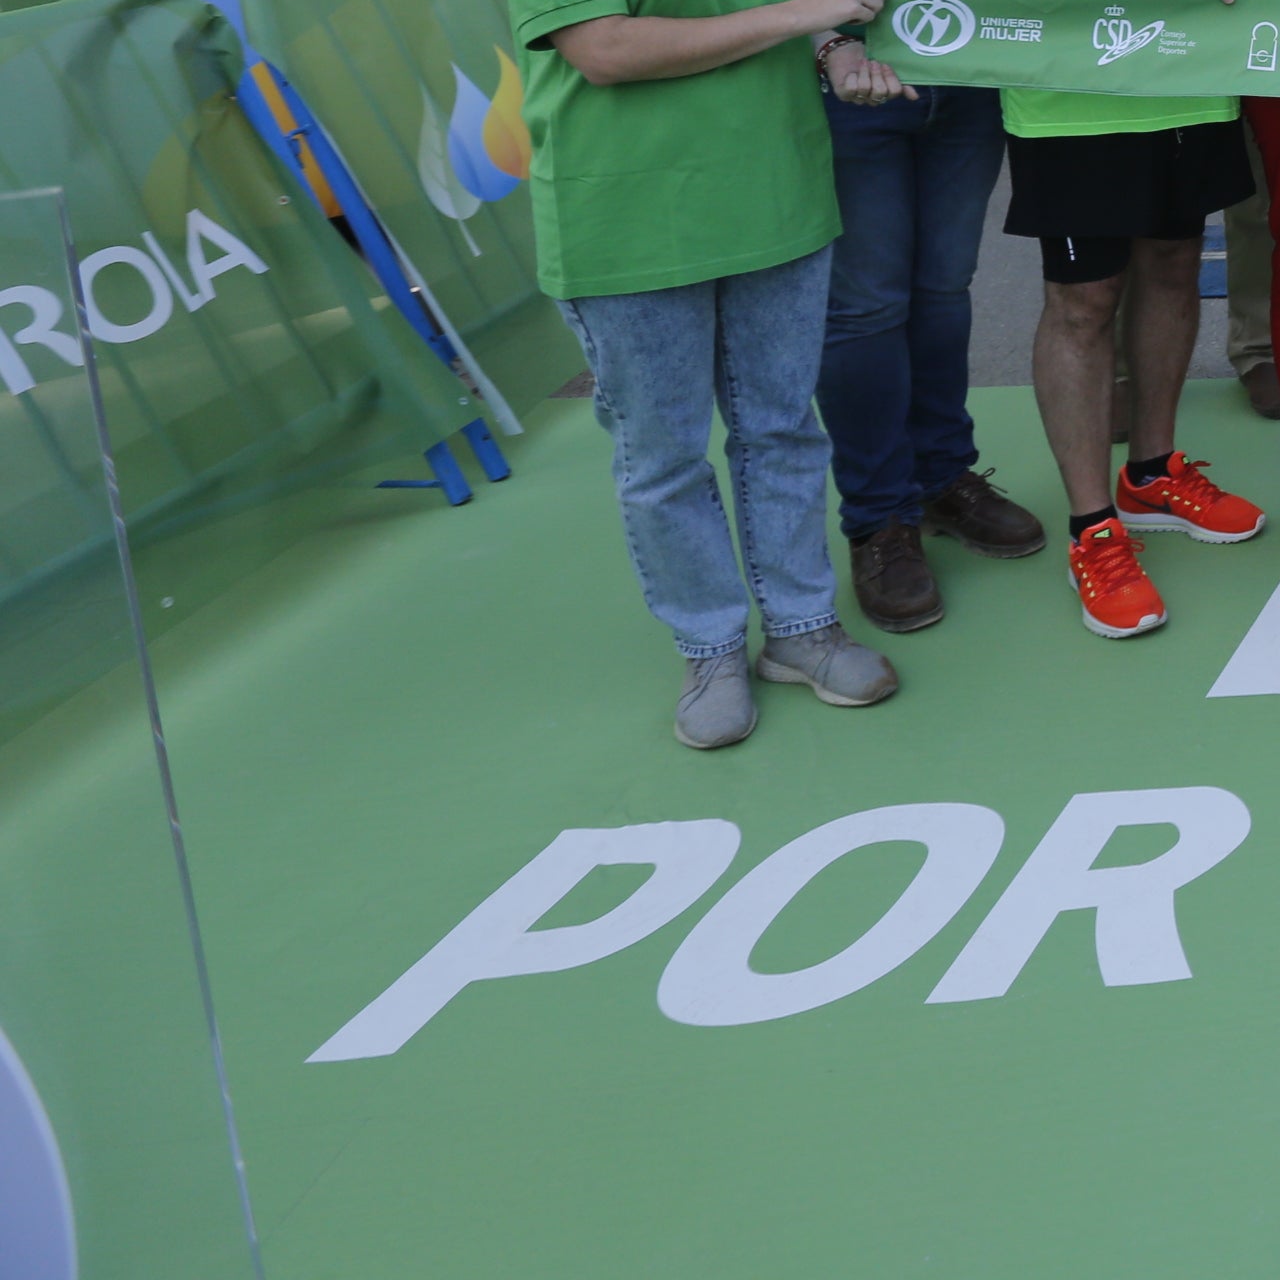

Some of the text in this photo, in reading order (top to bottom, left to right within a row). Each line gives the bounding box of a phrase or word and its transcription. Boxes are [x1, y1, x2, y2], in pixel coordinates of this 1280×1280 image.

[980, 16, 1043, 28] UNIVERSO
[980, 28, 1041, 43] MUJER
[1092, 18, 1131, 50] CSD
[305, 784, 1253, 1063] POR
